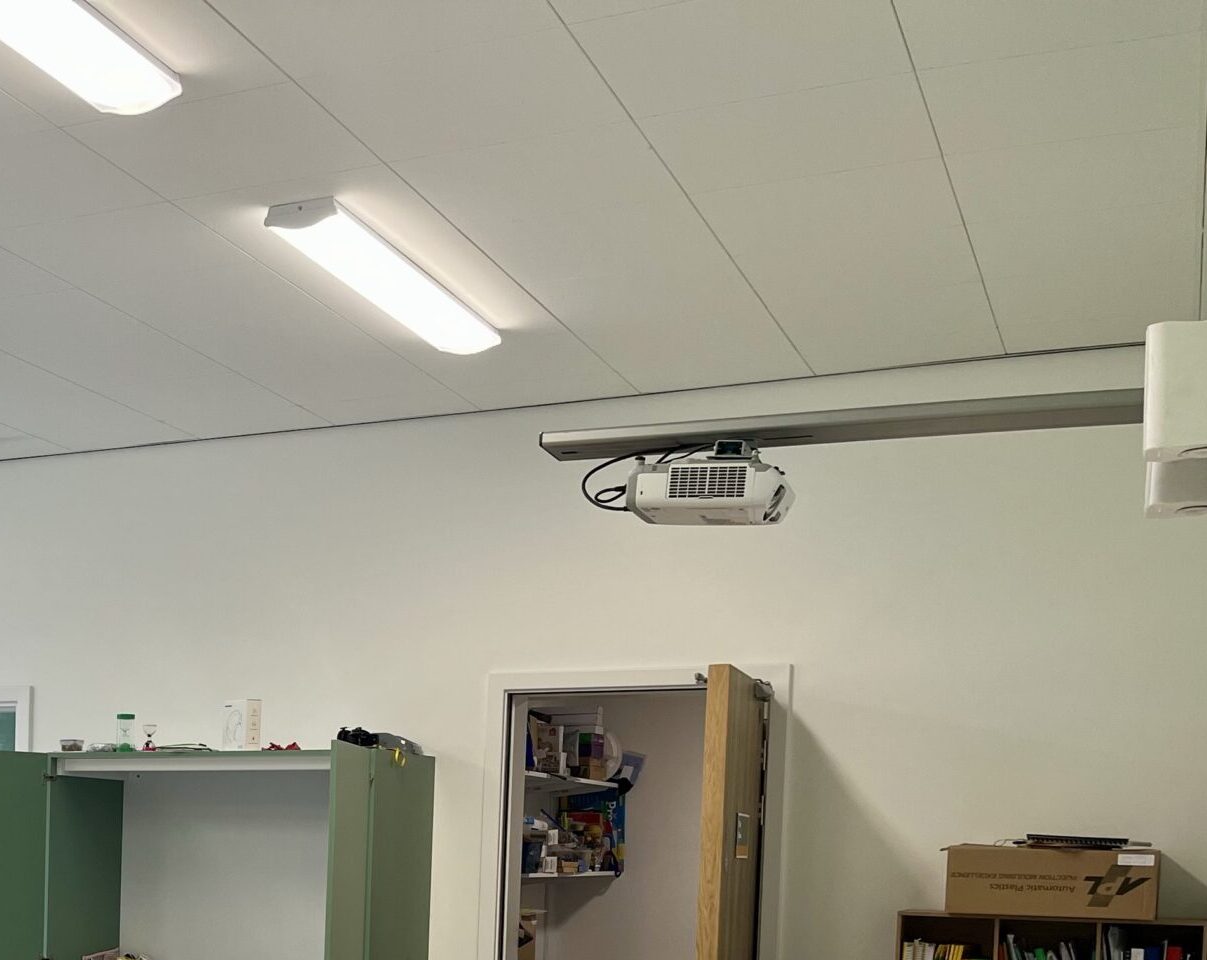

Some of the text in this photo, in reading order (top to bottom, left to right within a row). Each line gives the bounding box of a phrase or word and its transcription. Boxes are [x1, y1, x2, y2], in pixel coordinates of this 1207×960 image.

[989, 882, 1076, 893] Automatic Plastics
[1083, 876, 1152, 896] APL
